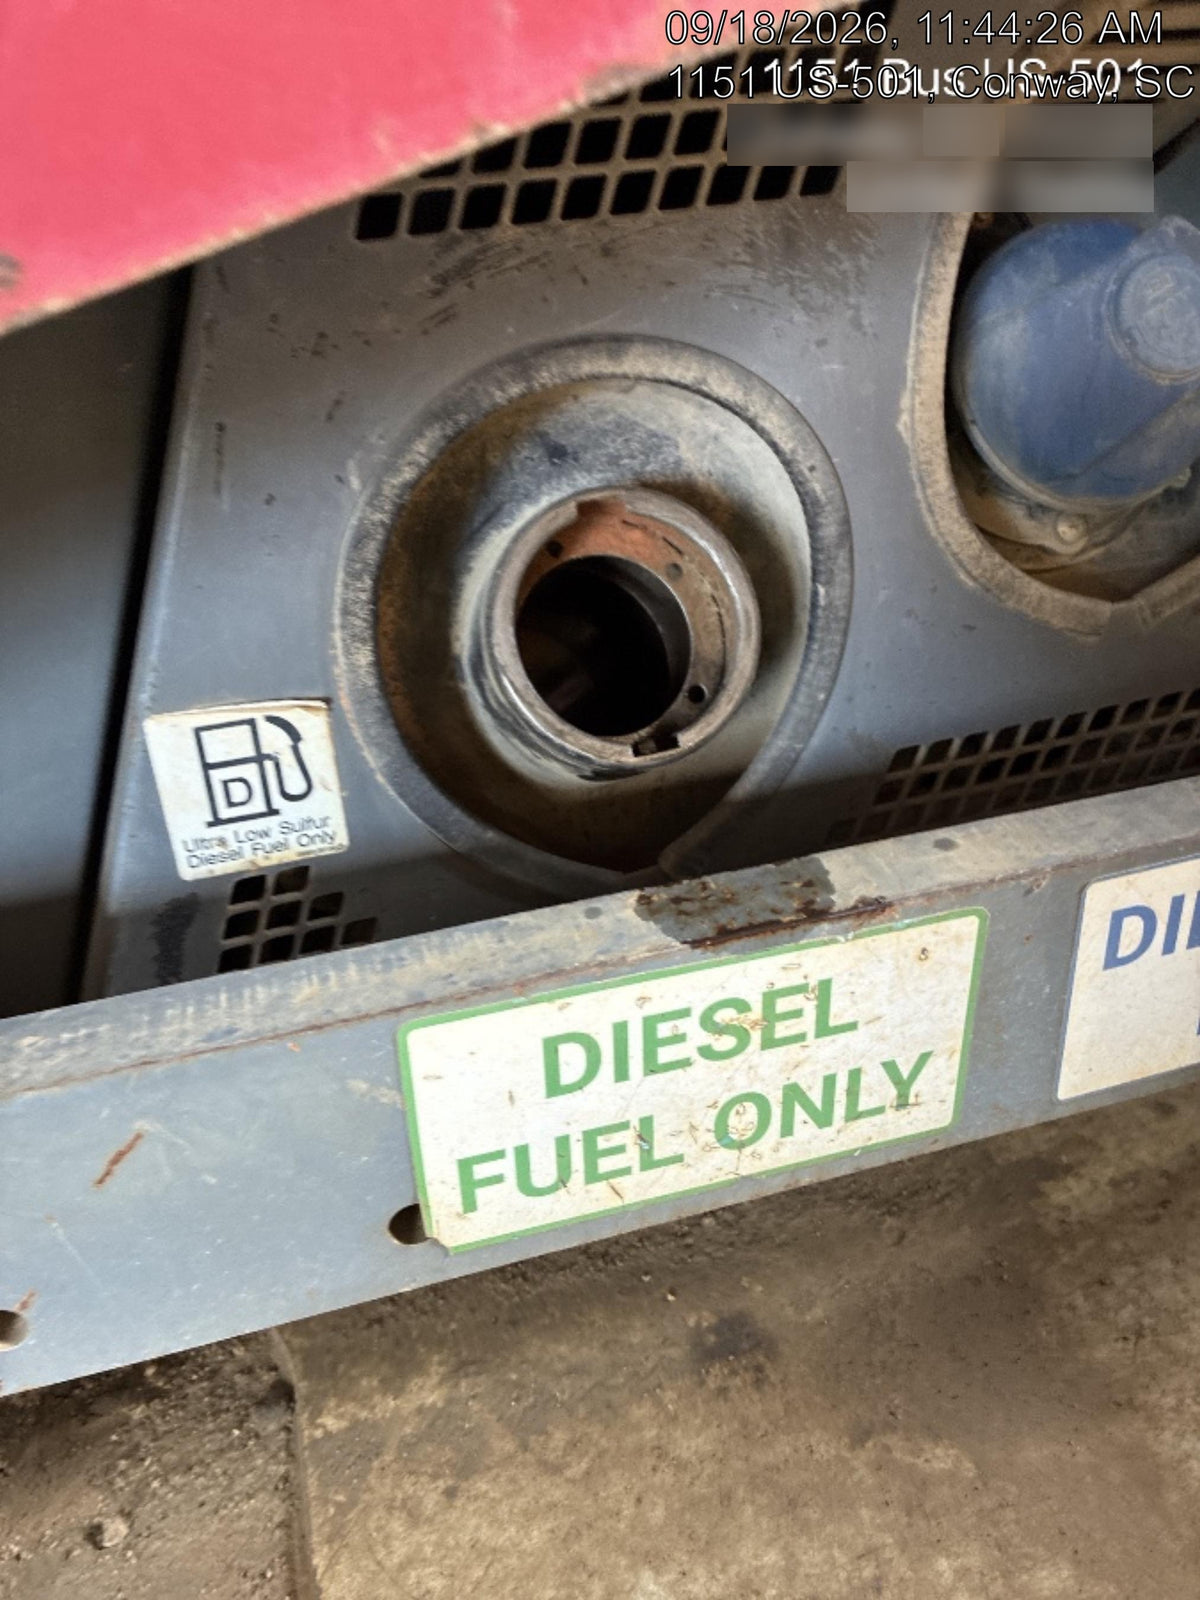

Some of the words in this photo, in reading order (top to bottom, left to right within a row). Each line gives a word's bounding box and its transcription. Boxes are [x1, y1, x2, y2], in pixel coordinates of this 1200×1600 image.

[182, 836, 227, 852] Ultra
[233, 828, 270, 843] Low
[279, 815, 330, 835] Sulfur
[186, 849, 244, 868] Diesel
[250, 837, 290, 856] Fuel
[296, 830, 336, 847] Only
[541, 977, 858, 1100] DIESEL
[456, 1115, 685, 1215] FUEL
[713, 1050, 934, 1152] ONLY
